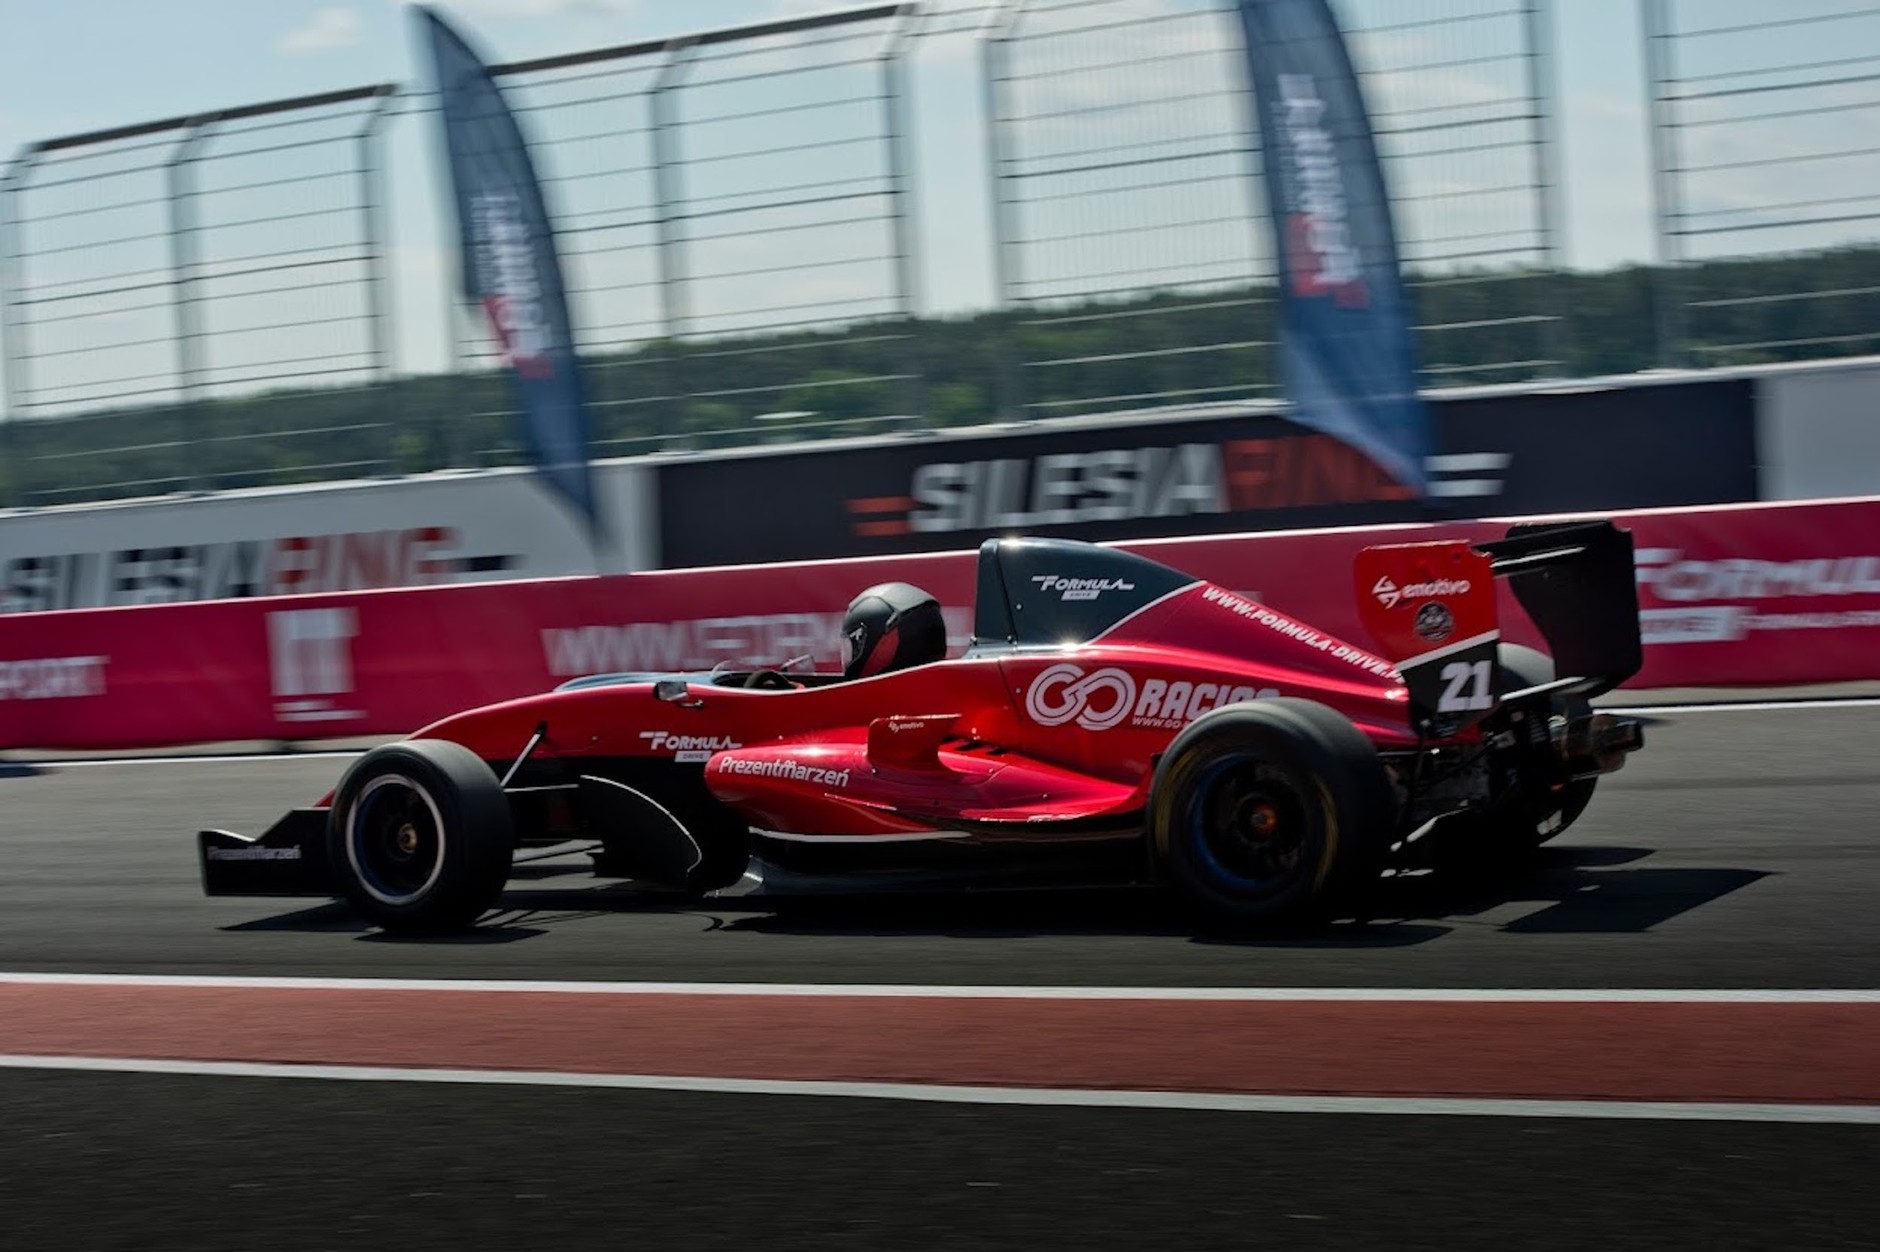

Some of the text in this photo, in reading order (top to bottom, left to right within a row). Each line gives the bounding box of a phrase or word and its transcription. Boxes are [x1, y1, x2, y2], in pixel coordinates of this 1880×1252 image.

[1031, 575, 1135, 591] FORMULA
[1437, 660, 1494, 713] 21
[639, 731, 743, 750] FORMULA
